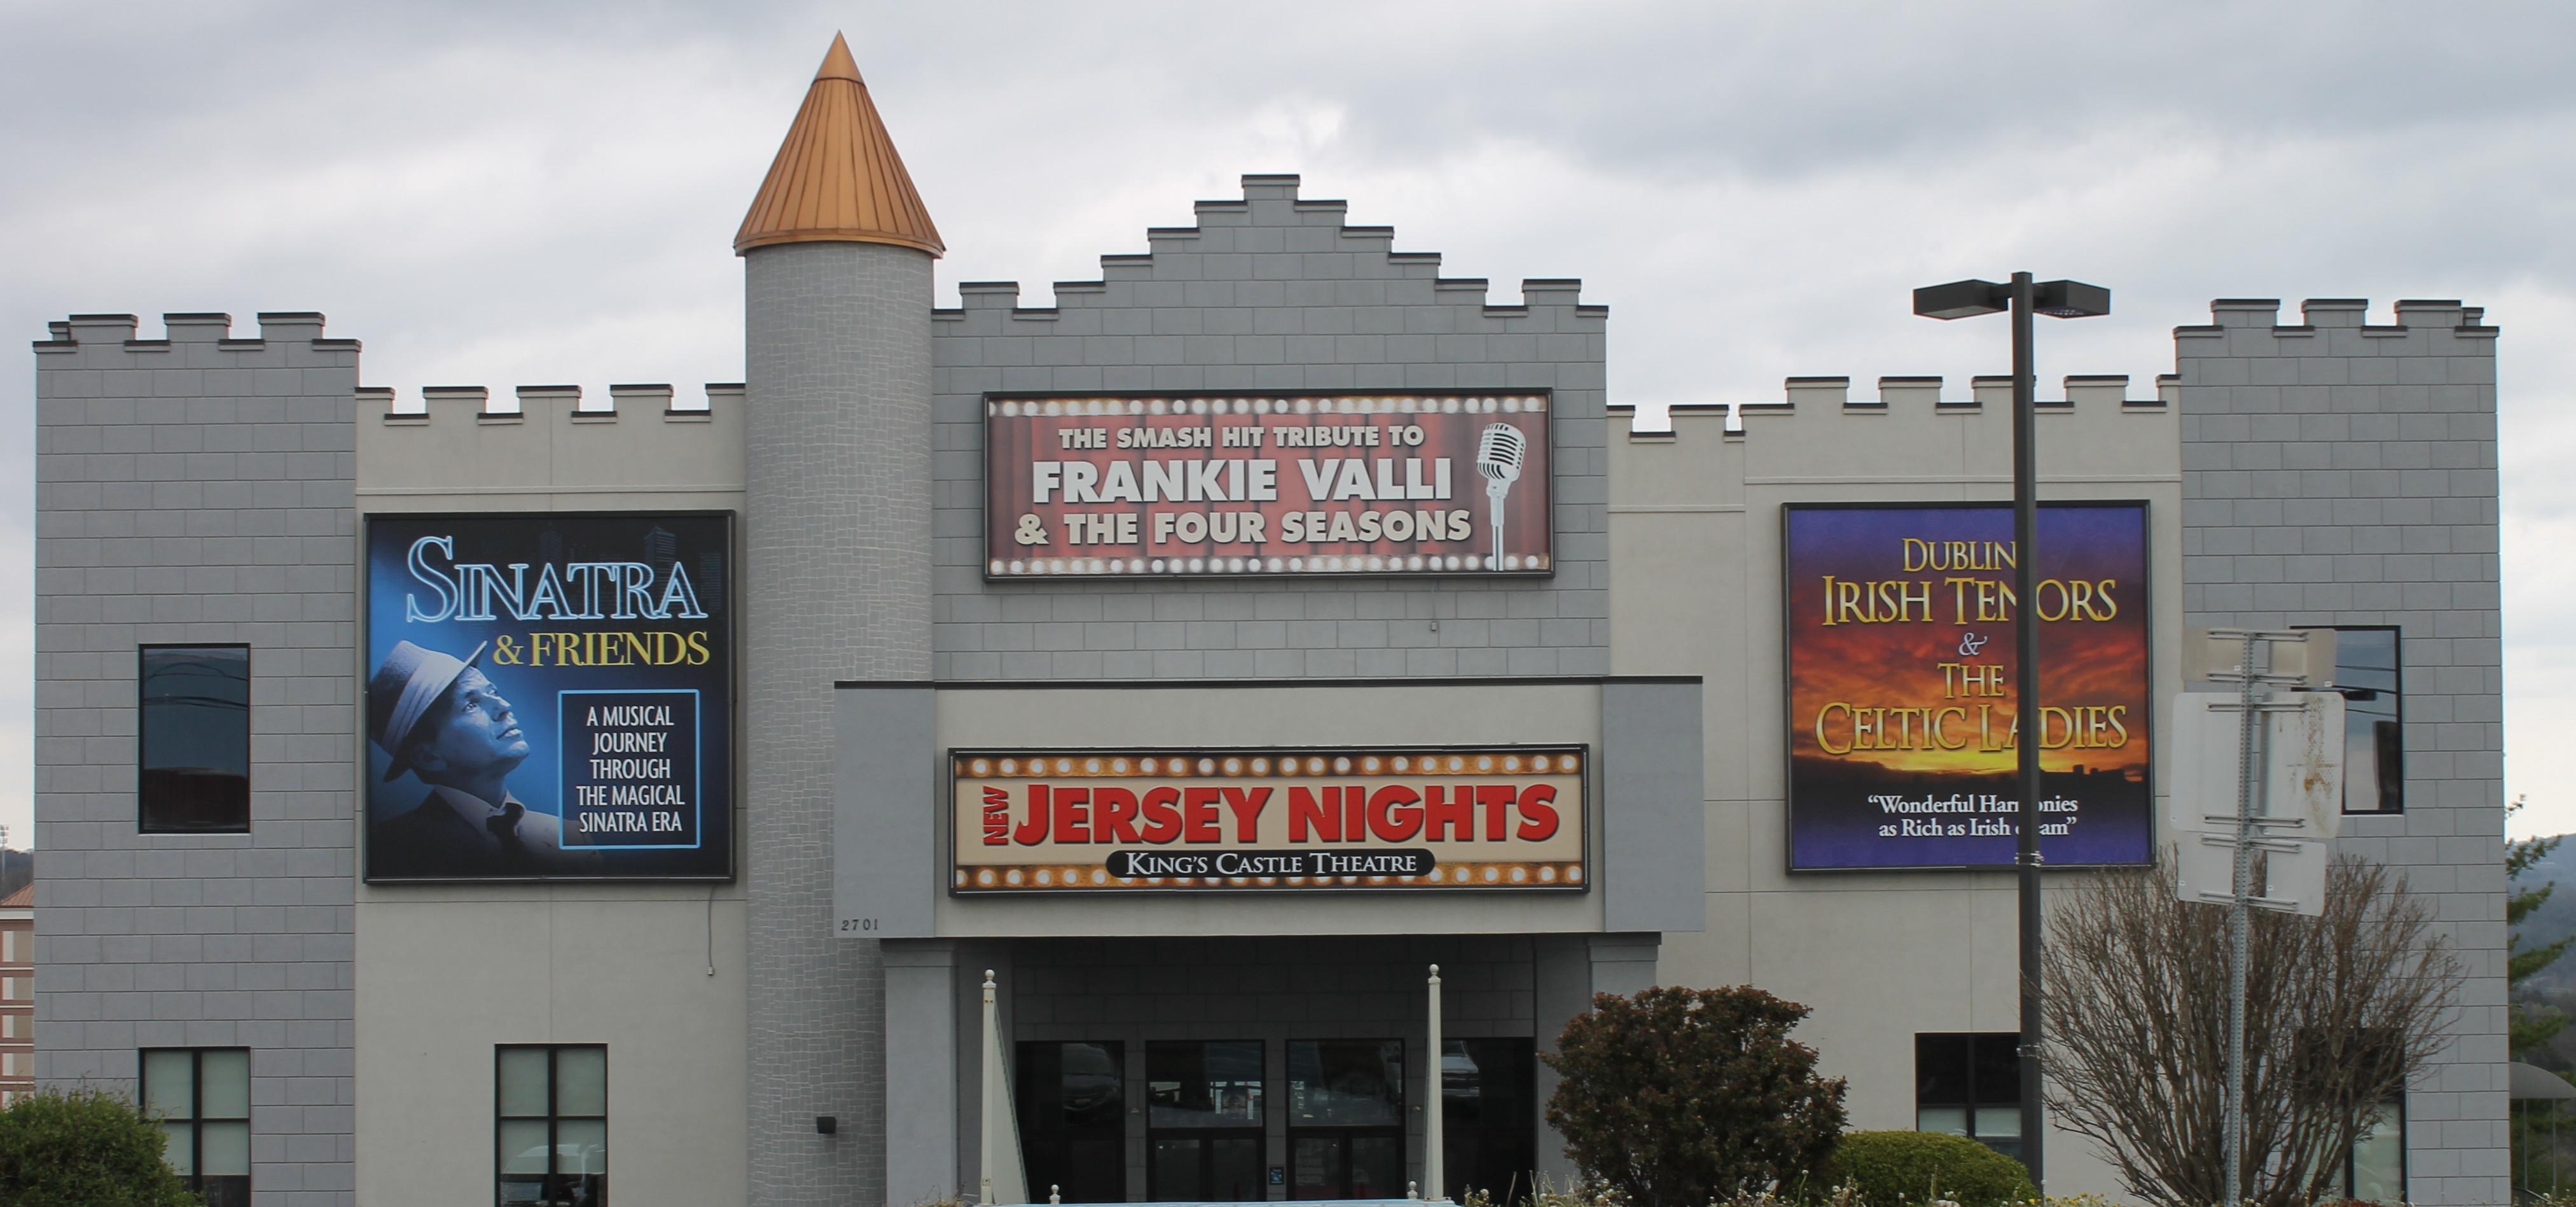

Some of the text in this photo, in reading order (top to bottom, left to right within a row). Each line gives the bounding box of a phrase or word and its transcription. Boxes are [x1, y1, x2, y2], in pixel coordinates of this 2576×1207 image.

[1058, 425, 1424, 449] THE SMASH HIT TRIBUTE TO
[1032, 457, 1451, 503] FRANKIE VALLI
[1015, 510, 1472, 545] & THE FOUR SEASONS
[1902, 538, 2017, 571] DUBLIN
[406, 535, 709, 622] SINATRA
[1822, 575, 1932, 625] IRISH
[493, 631, 710, 666] & FRIENDS
[1958, 632, 1987, 655] &
[1937, 663, 2004, 699] THE
[586, 706, 674, 727] A MUSICAL
[1815, 702, 1967, 755] CELTIC
[592, 732, 667, 755] JOURNEY
[590, 758, 670, 779] THROUGH
[576, 785, 685, 806] THE MAGICAL
[1979, 795, 2078, 813] Harnies
[579, 811, 682, 833] SINATRA ERA
[983, 786, 1009, 846] NEW
[1014, 784, 1560, 845] JERSEY NIGHTS
[1878, 825, 1897, 837] as
[1901, 818, 1944, 837] Rich
[1947, 824, 1965, 836] as
[1969, 817, 2011, 836] Irish
[1125, 852, 1417, 875] KING’S CASTLE THEATRE
[841, 919, 878, 931] 2701
